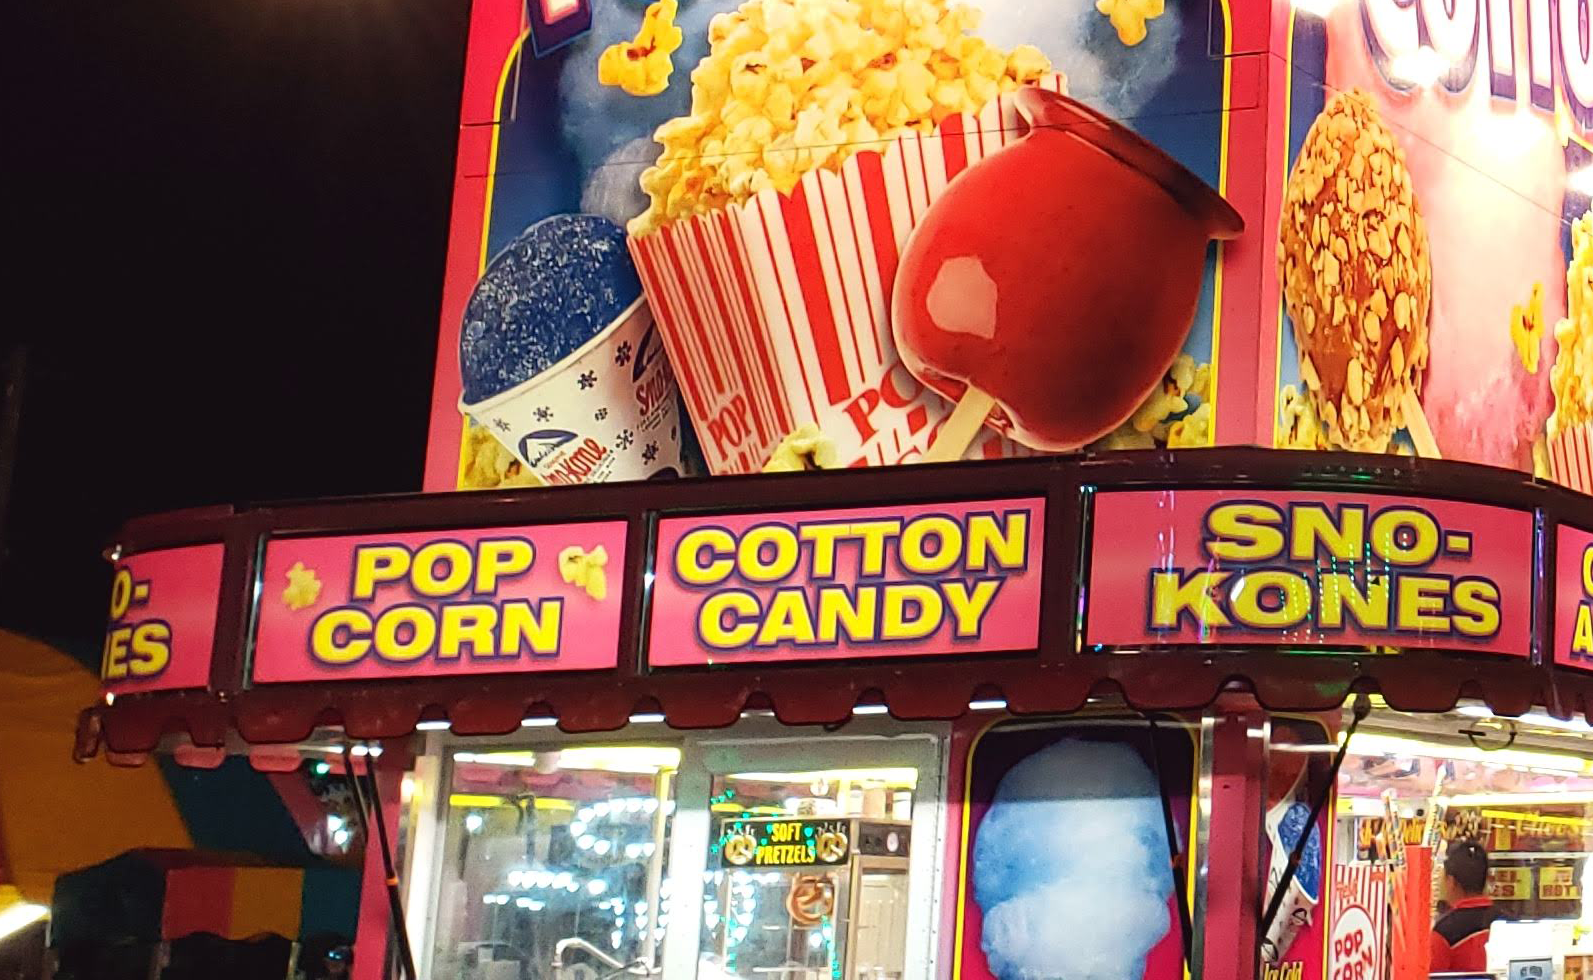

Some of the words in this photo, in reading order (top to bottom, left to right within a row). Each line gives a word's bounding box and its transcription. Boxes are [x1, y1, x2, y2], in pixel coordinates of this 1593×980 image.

[705, 393, 753, 463] POP
[842, 361, 928, 447] PO
[675, 511, 1029, 585] COTTON
[1204, 502, 1472, 565] SNO-
[110, 567, 150, 620] O-
[352, 538, 535, 600] POP
[311, 600, 563, 664] CORN
[700, 579, 1001, 649] CANDY
[1150, 569, 1500, 637] KONES
[101, 621, 171, 679] ES
[755, 844, 816, 866] PRETZELS
[770, 822, 802, 843] SOFT
[1334, 928, 1365, 963] POP
